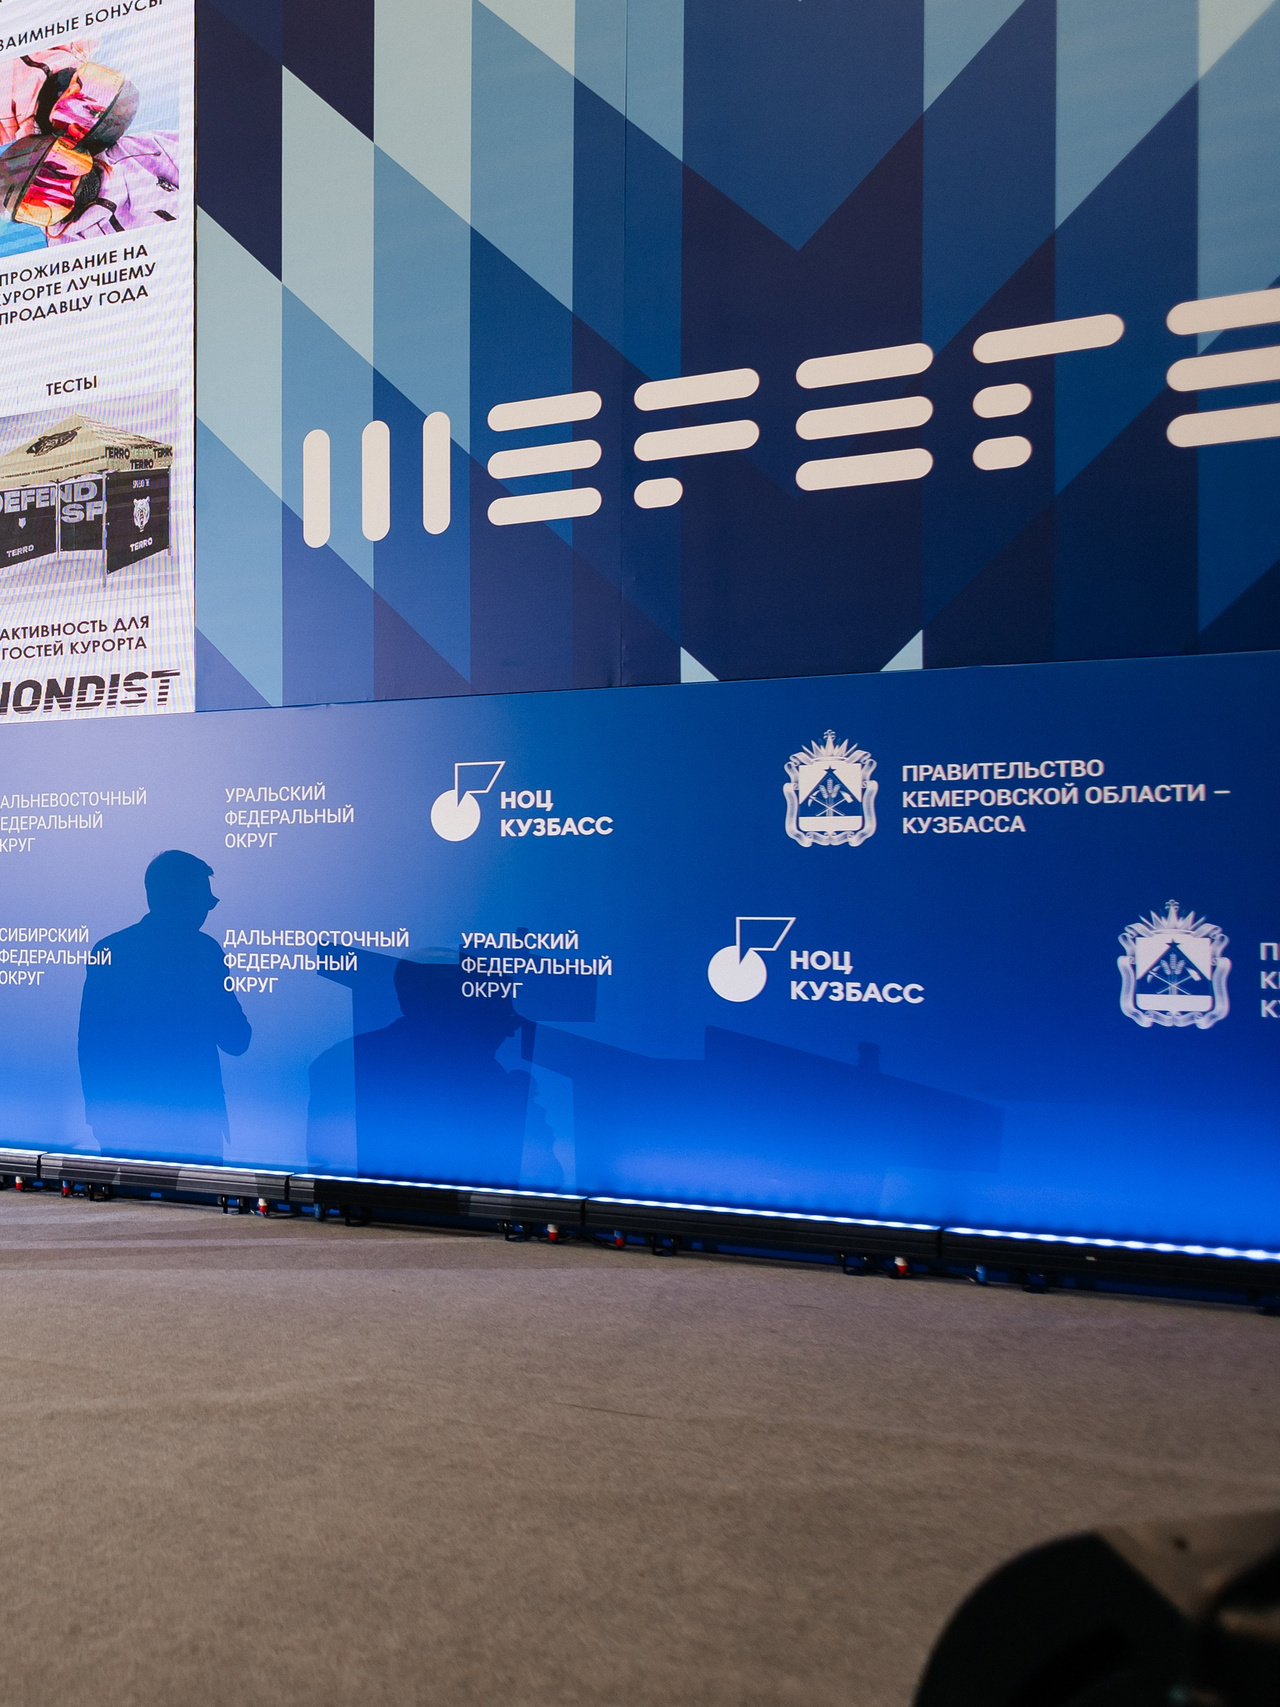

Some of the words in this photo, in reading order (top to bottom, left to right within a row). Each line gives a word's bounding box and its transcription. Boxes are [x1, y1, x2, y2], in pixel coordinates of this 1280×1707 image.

[0, 250, 117, 287] ПРОЖИВАНИЕ
[123, 244, 148, 260] НА
[66, 262, 156, 293] ЛУЧШЕМУ
[99, 285, 149, 306] ГОДА
[46, 375, 98, 397] ТЕСТЫ
[0, 619, 108, 641] АКТИВНОСТЬ
[113, 615, 149, 633] ДЛЯ
[2, 640, 63, 660] ГОСТЕЙ
[70, 636, 147, 655] КУРОРТА
[902, 758, 1105, 783] ПРАВИТЕЛЬСТВО
[225, 782, 326, 803] УРАЛЬСКИЙ
[500, 790, 554, 811] НОЦ
[902, 783, 1080, 809] КЕМЕРОВСКОЙ
[1085, 783, 1206, 805] ОБЛАСТИ
[224, 804, 354, 829] ФЕДЕРАЛЬНЫЙ
[500, 816, 614, 837] КУЗБАСС
[902, 816, 1027, 834] КУЗБАССА
[224, 832, 278, 849] ОКРУГ
[223, 928, 410, 949] ДАЛЬНЕВОСТОЧНЫЙ
[461, 929, 579, 950] УРАЛЬСКИЙ
[223, 951, 358, 973] ФЕДЕРАЛЬНЫЙ
[461, 955, 613, 976] ФЕДЕРАЛЬНЫЙ
[789, 949, 853, 975] НОЦ
[223, 976, 279, 993] ОКРУГ
[461, 981, 523, 999] ОКРУГ
[789, 980, 925, 1005] КУЗБАСС
